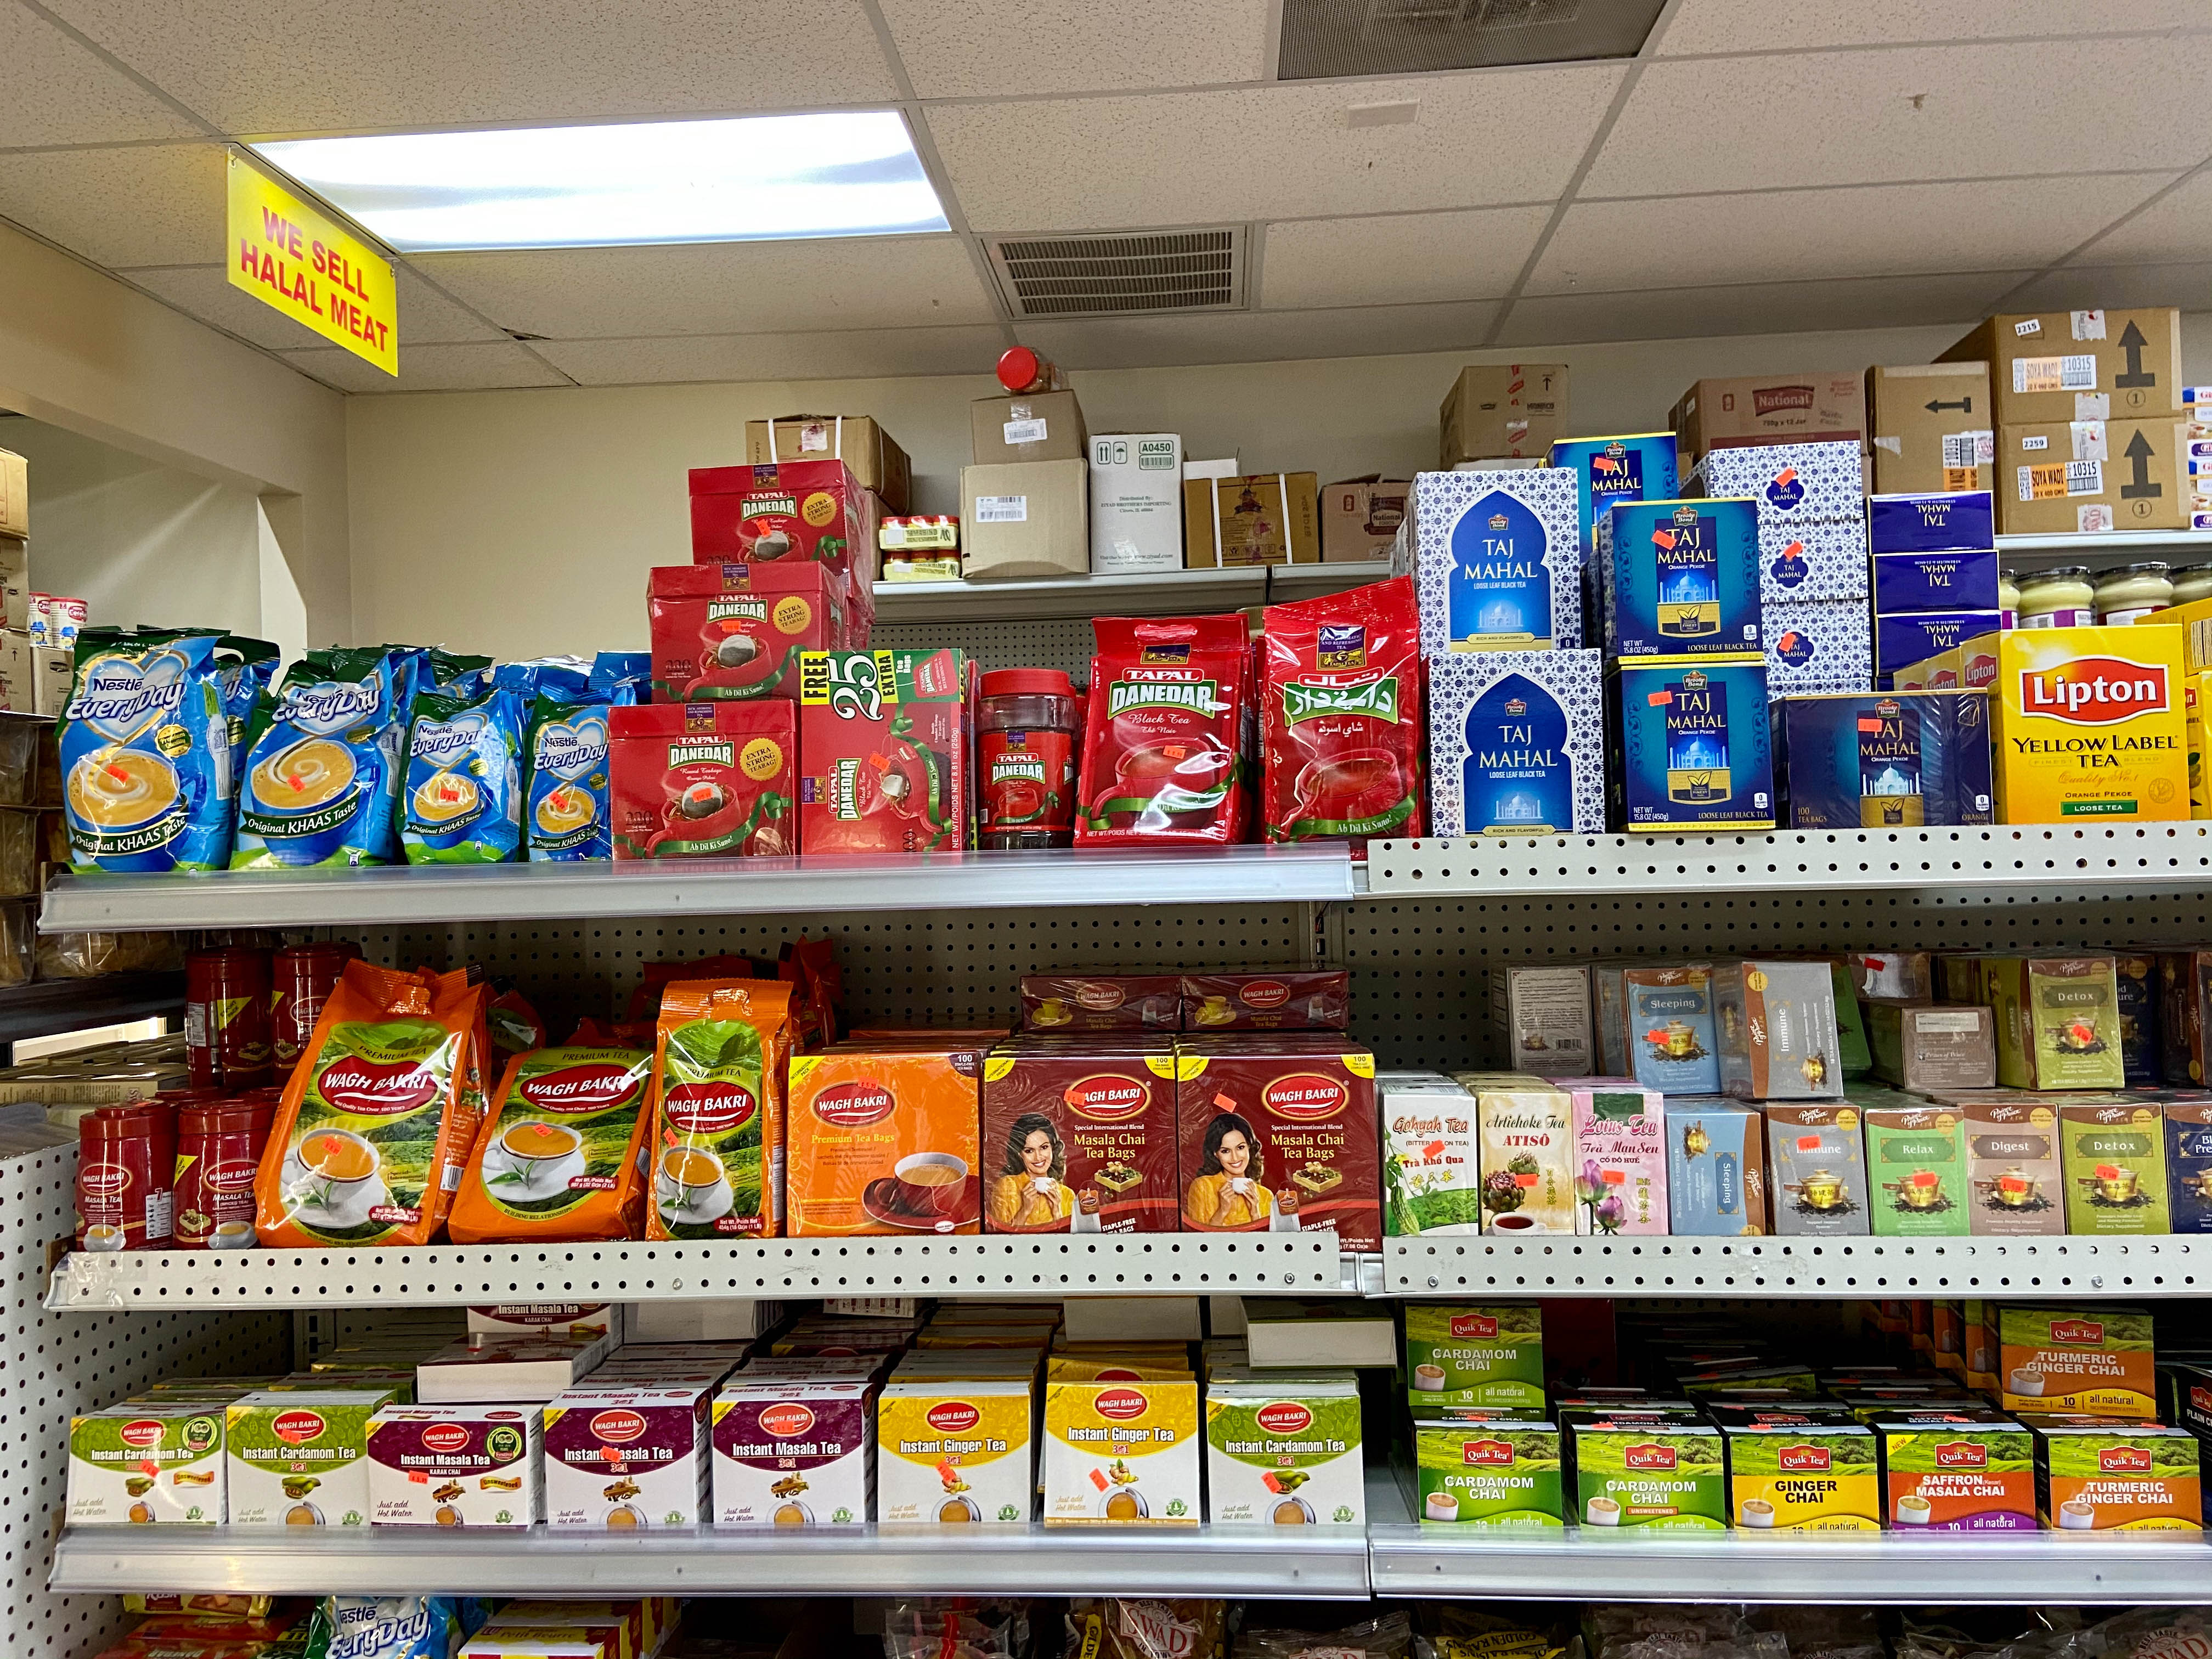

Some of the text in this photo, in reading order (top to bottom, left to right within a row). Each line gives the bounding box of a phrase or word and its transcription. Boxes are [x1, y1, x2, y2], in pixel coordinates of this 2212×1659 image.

[263, 206, 369, 302] WE SELL
[241, 238, 387, 352] HALAL MEAT
[1758, 394, 1809, 407] National
[1142, 443, 1170, 452] A0450
[2073, 462, 2096, 476] 10315
[2032, 471, 2047, 487] SOYA
[2048, 469, 2063, 485] WADI
[742, 500, 796, 520] DANEDAR
[1915, 505, 1950, 513] MAHAL
[1925, 516, 1945, 526] TAJ
[1482, 539, 1514, 557] TAJ
[1464, 563, 1538, 579] MAHAL
[1127, 669, 1199, 681] TAPAL
[1967, 664, 1994, 681] Lipton
[804, 653, 894, 720] FREE 25 EXTRA
[1112, 684, 1215, 713] DANEDAR
[2033, 675, 2158, 712] Lipton
[66, 682, 184, 722] EveryDay
[1676, 693, 1711, 713] TAJ
[1129, 714, 1190, 724] Black Tea
[1667, 715, 1725, 729] MAHAL
[1343, 722, 1363, 735] شاي
[1860, 742, 1919, 755] MAHAL
[2012, 735, 2176, 753] YELLOW LABEL
[534, 743, 608, 769] EveryDay
[670, 747, 731, 765] DANEDAR
[746, 747, 771, 760] EXTRA
[746, 753, 775, 768] STRONG
[2077, 754, 2119, 767] TEA
[829, 768, 837, 812] TAPAL
[838, 760, 861, 819] DANEDAR
[248, 802, 357, 834] Original KHAAS Taste
[717, 836, 733, 848] Suno!
[1651, 998, 1695, 1010] Sleeping
[1781, 1009, 1789, 1052] Immune
[562, 1052, 609, 1060] PREMIUM
[1270, 1088, 1338, 1102] WAGH BAKRI
[668, 1094, 747, 1113] WAGH BAKRI
[819, 1095, 887, 1111] WAGH BAKRI
[1393, 1115, 1469, 1141] Gohyah Tea
[1486, 1114, 1566, 1129] Artichoke Tea
[1579, 1114, 1658, 1138] Lotus Tea
[812, 1133, 895, 1143] Premium Tea Bags
[1271, 1133, 1344, 1146] Masala Chai
[1503, 1134, 1549, 1146] ATISÔ
[1581, 1142, 1602, 1154] Trà
[1903, 1145, 1933, 1154] Relax
[1991, 1142, 2029, 1153] Digest
[2094, 1142, 2135, 1150] Detox
[1282, 1147, 1334, 1159] Tea Bags
[1403, 1159, 1420, 1167] Trà
[1446, 1156, 1464, 1164] Qua
[1723, 1163, 1731, 1204] Sleeping
[1455, 1324, 1492, 1334] Quik Tea
[1432, 1348, 1517, 1360] CARDAMOM
[2038, 1352, 2116, 1364] TURMERIC
[1455, 1359, 1491, 1371] CHAI
[2027, 1362, 2125, 1376] GINGER CHAI
[1462, 1391, 1472, 1400] 10
[1486, 1386, 1525, 1396] all natural
[277, 1420, 319, 1430] WAGH BAKRI
[900, 1438, 1006, 1453] Instant Ginger Tea
[1892, 1437, 1908, 1452] NEW
[243, 1446, 356, 1460] Instant Cardamom Tea
[400, 1454, 490, 1466] Instant Masala Tea
[1775, 1480, 1837, 1492] GINGER
[1923, 1475, 1983, 1486] SAFFRON
[1785, 1491, 1824, 1503] CHAI
[1916, 1486, 2004, 1497] MASALA CHAI
[1125, 1609, 1187, 1652] SWAD
